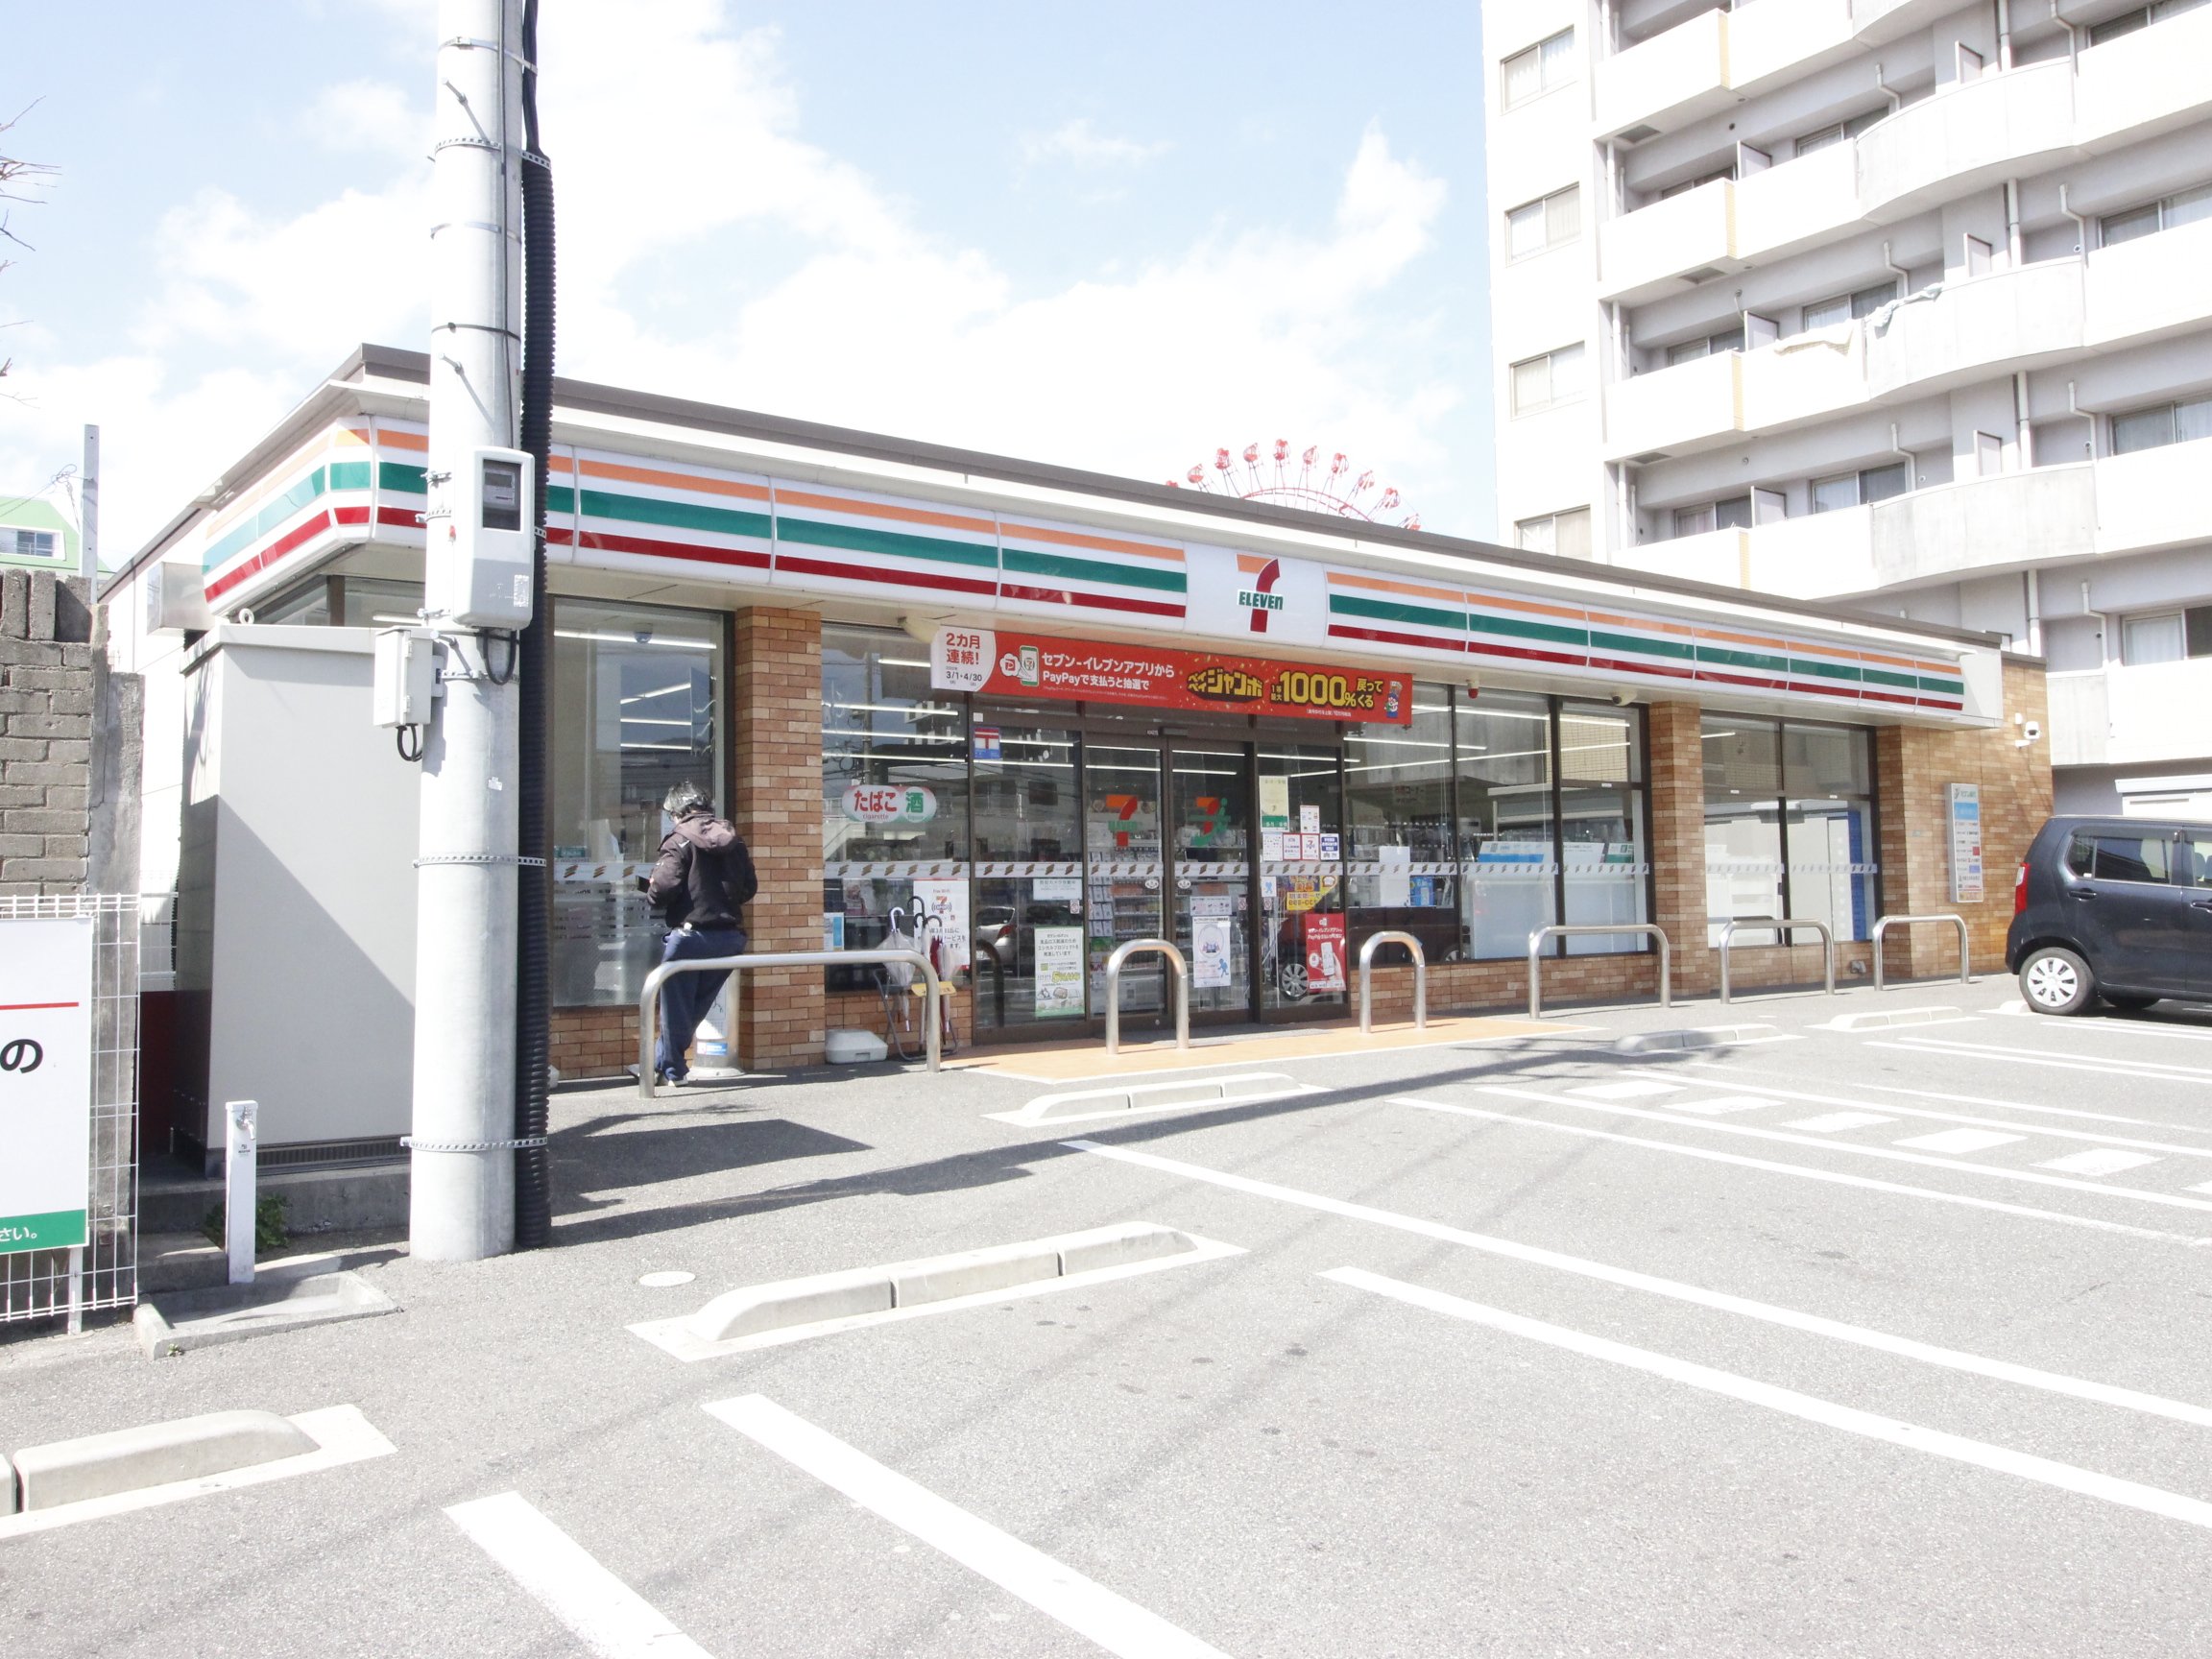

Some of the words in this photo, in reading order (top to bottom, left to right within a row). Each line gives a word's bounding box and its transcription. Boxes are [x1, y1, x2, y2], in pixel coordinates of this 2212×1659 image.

[946, 632, 980, 649] 2カ月
[1358, 677, 1383, 692] 戻って
[1357, 694, 1374, 708] くる
[854, 790, 898, 812] たばこ
[905, 791, 924, 813] 酒
[0, 1038, 44, 1074] の
